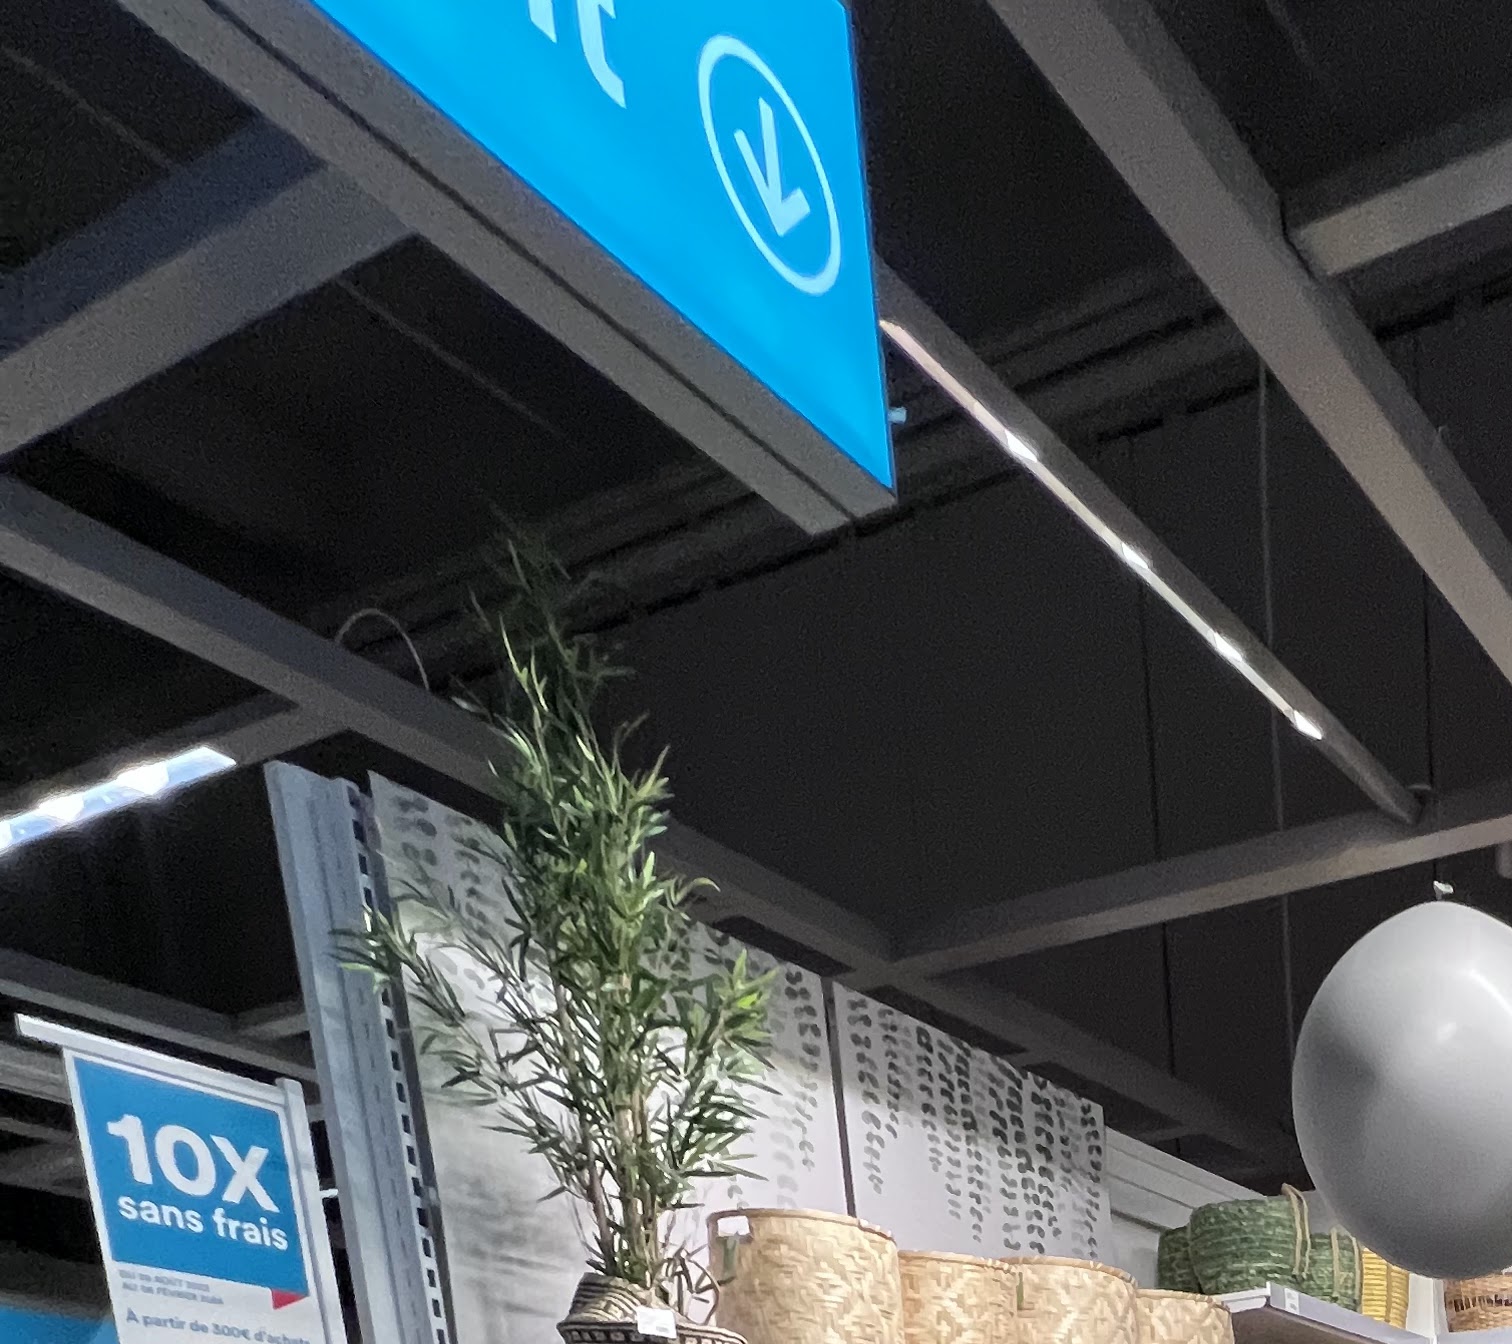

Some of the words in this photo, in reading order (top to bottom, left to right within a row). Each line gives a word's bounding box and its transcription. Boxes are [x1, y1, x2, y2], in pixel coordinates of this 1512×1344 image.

[107, 1114, 280, 1213] 10X
[118, 1196, 204, 1233] sans
[212, 1207, 289, 1250] frais
[189, 1320, 209, 1333] de
